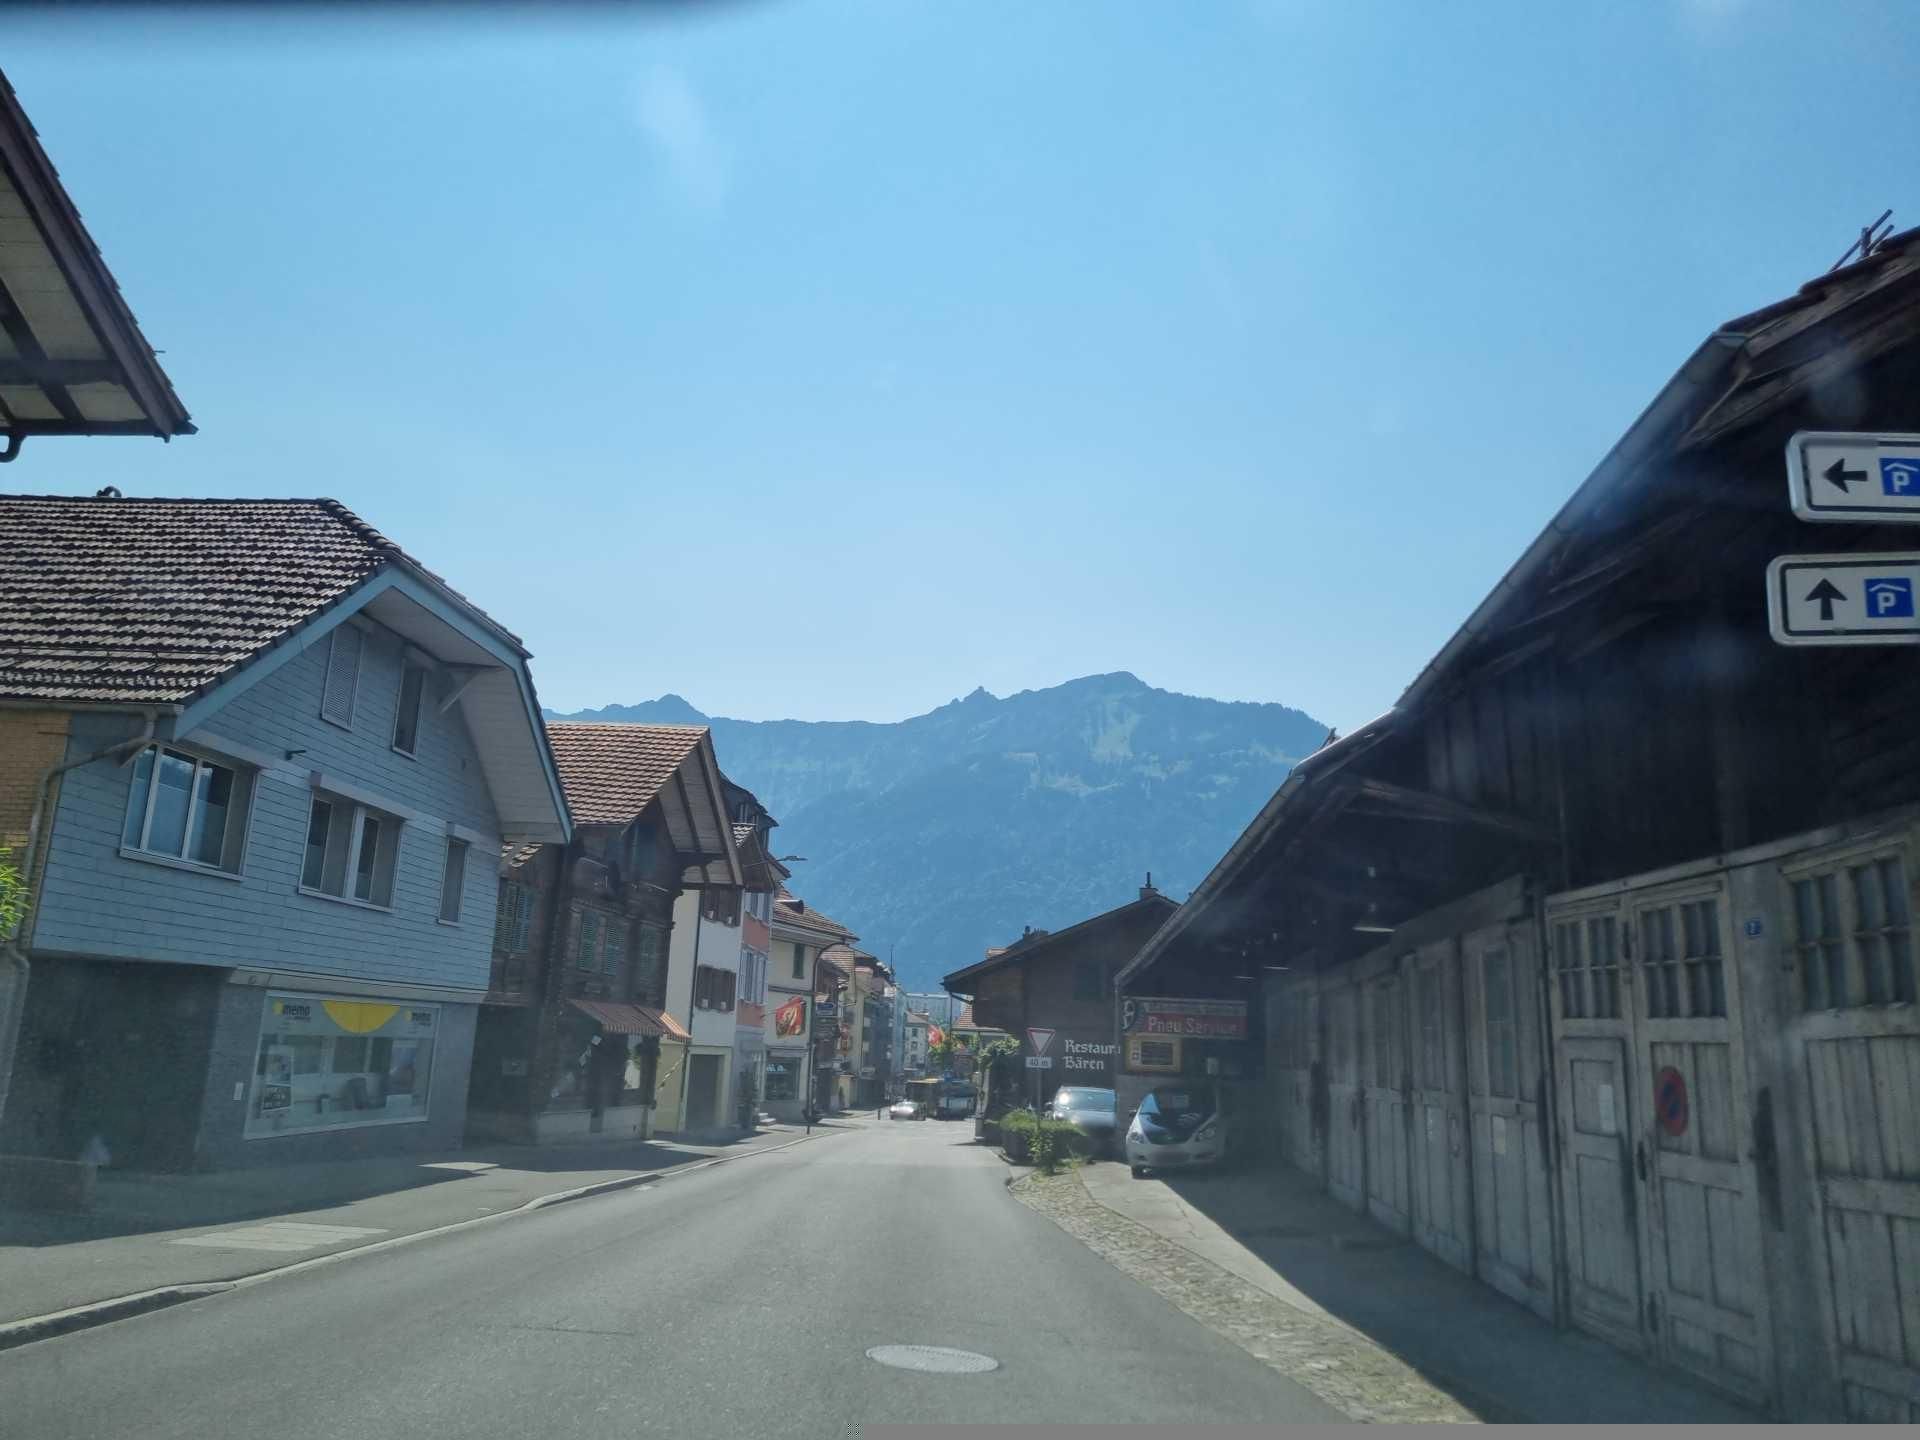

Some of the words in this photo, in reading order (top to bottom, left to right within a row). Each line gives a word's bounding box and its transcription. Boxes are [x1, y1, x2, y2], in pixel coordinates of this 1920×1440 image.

[1892, 471, 1911, 493] P
[1877, 592, 1896, 614] P
[1147, 1016, 1182, 1033] Pneu
[1063, 1055, 1105, 1070] Bären
